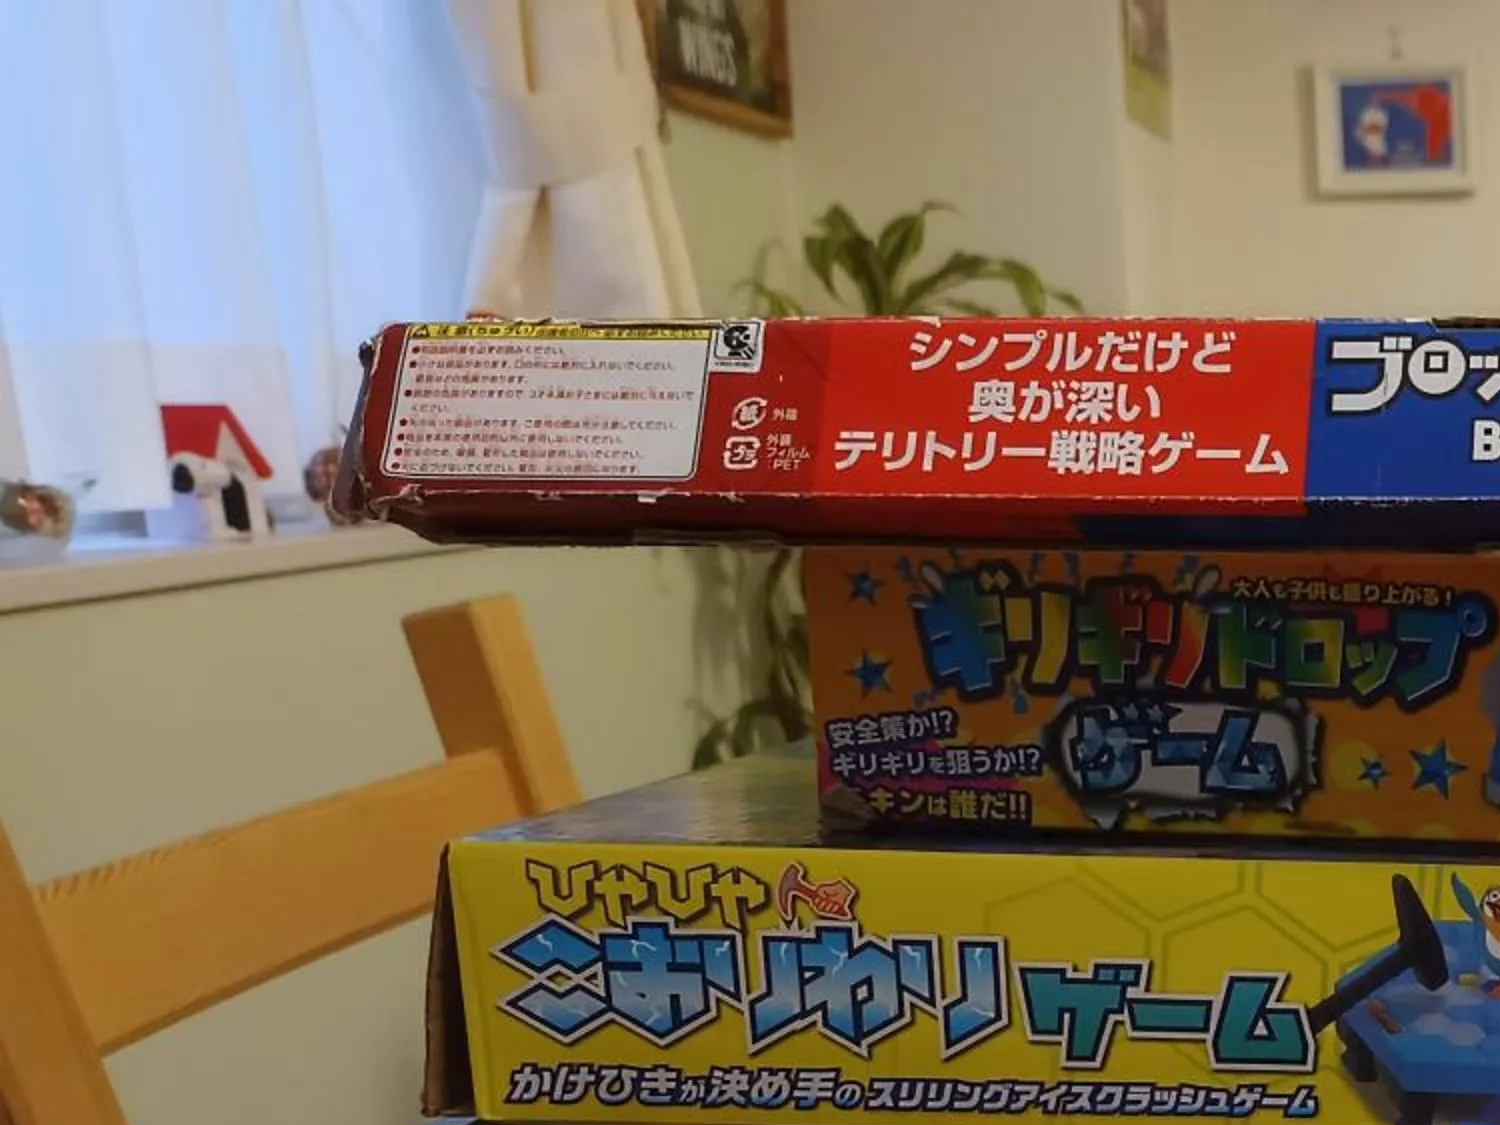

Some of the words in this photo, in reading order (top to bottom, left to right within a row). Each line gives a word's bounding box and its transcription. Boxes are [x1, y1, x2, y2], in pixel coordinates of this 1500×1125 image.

[908, 329, 1238, 375] シンプルだけど
[968, 379, 1162, 424] 奥が深い
[833, 430, 1290, 476] テリトリー戦略ゲーム
[856, 788, 1027, 820] キンは誰だ!!
